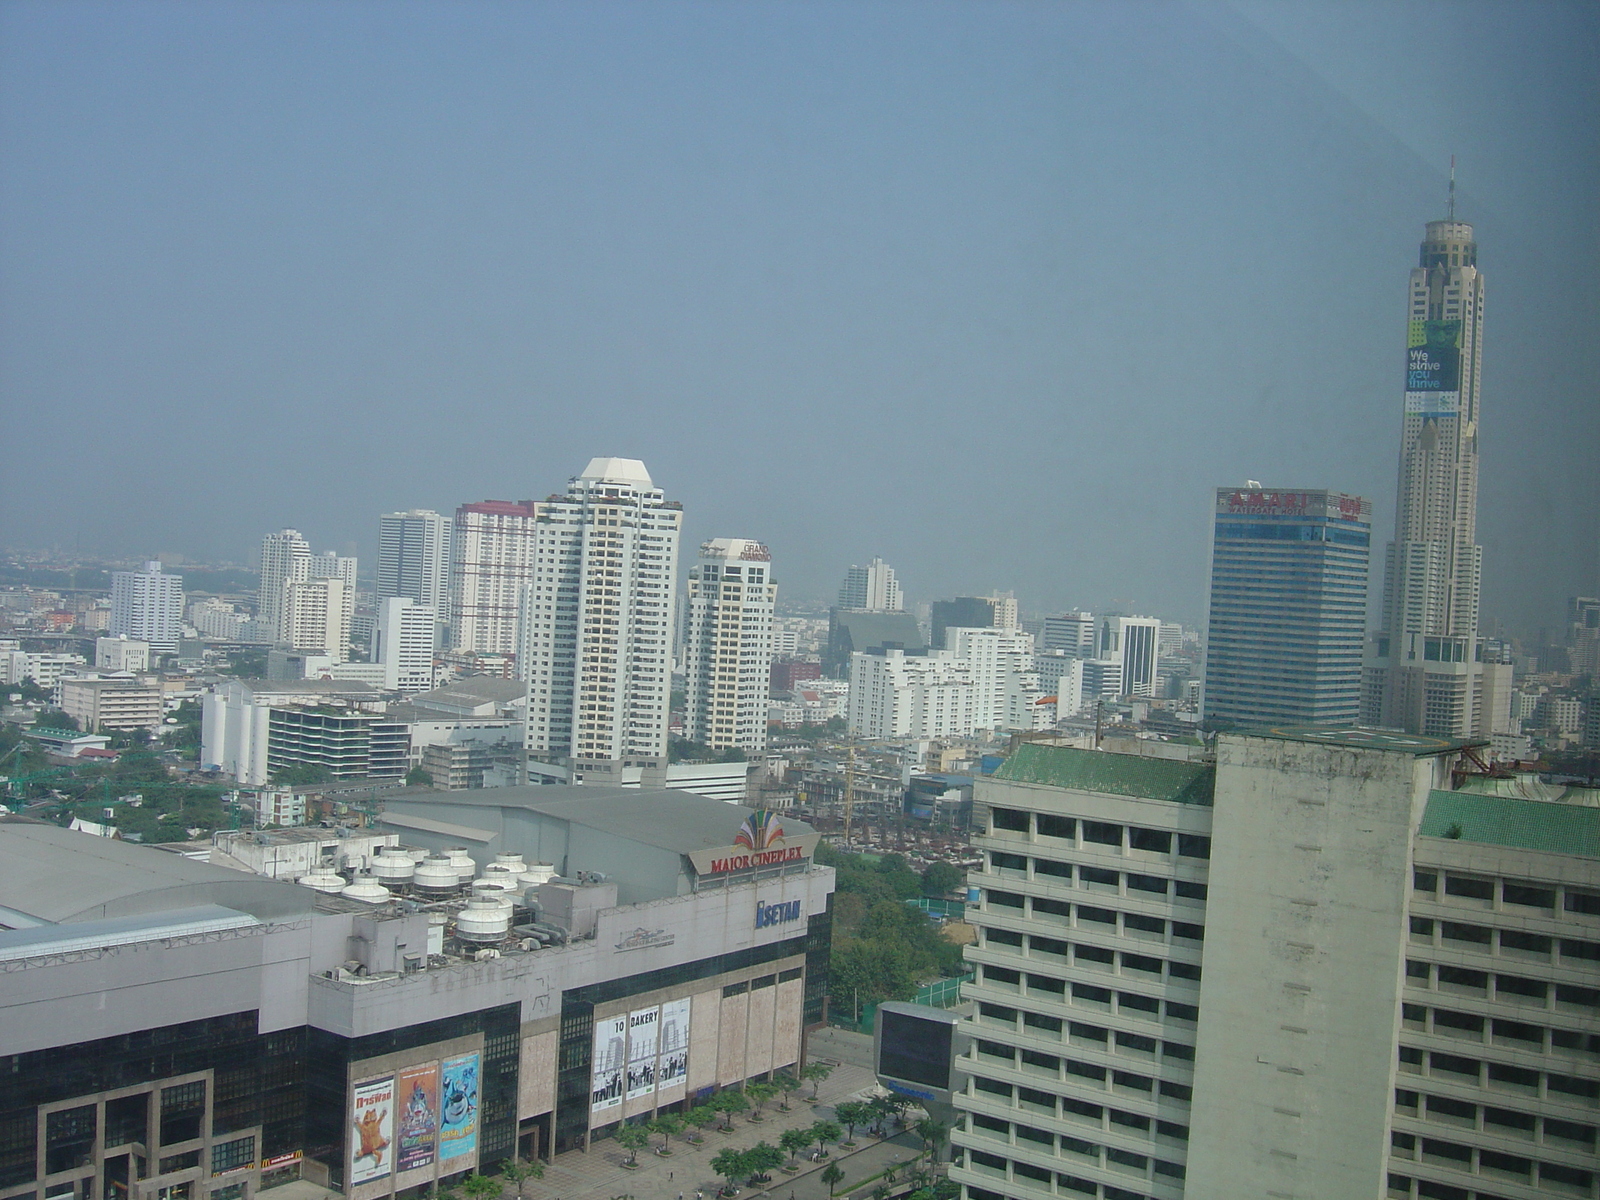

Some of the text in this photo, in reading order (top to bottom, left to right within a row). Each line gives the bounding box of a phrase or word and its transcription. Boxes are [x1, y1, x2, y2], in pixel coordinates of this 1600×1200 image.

[1410, 350, 1428, 360] We
[1409, 360, 1440, 371] strive
[1409, 370, 1430, 380] you
[1409, 378, 1440, 388] thrive
[1229, 490, 1307, 508] AMARI
[1228, 506, 1306, 516] WATERGATE HOTEL
[744, 544, 769, 554] GRAND
[740, 551, 772, 562] DIAMOND
[711, 846, 803, 873] MAJOR CINEPLEX
[615, 1021, 625, 1033] 10
[630, 1010, 659, 1028] BAKERY
[888, 1080, 935, 1101] Panasonic
